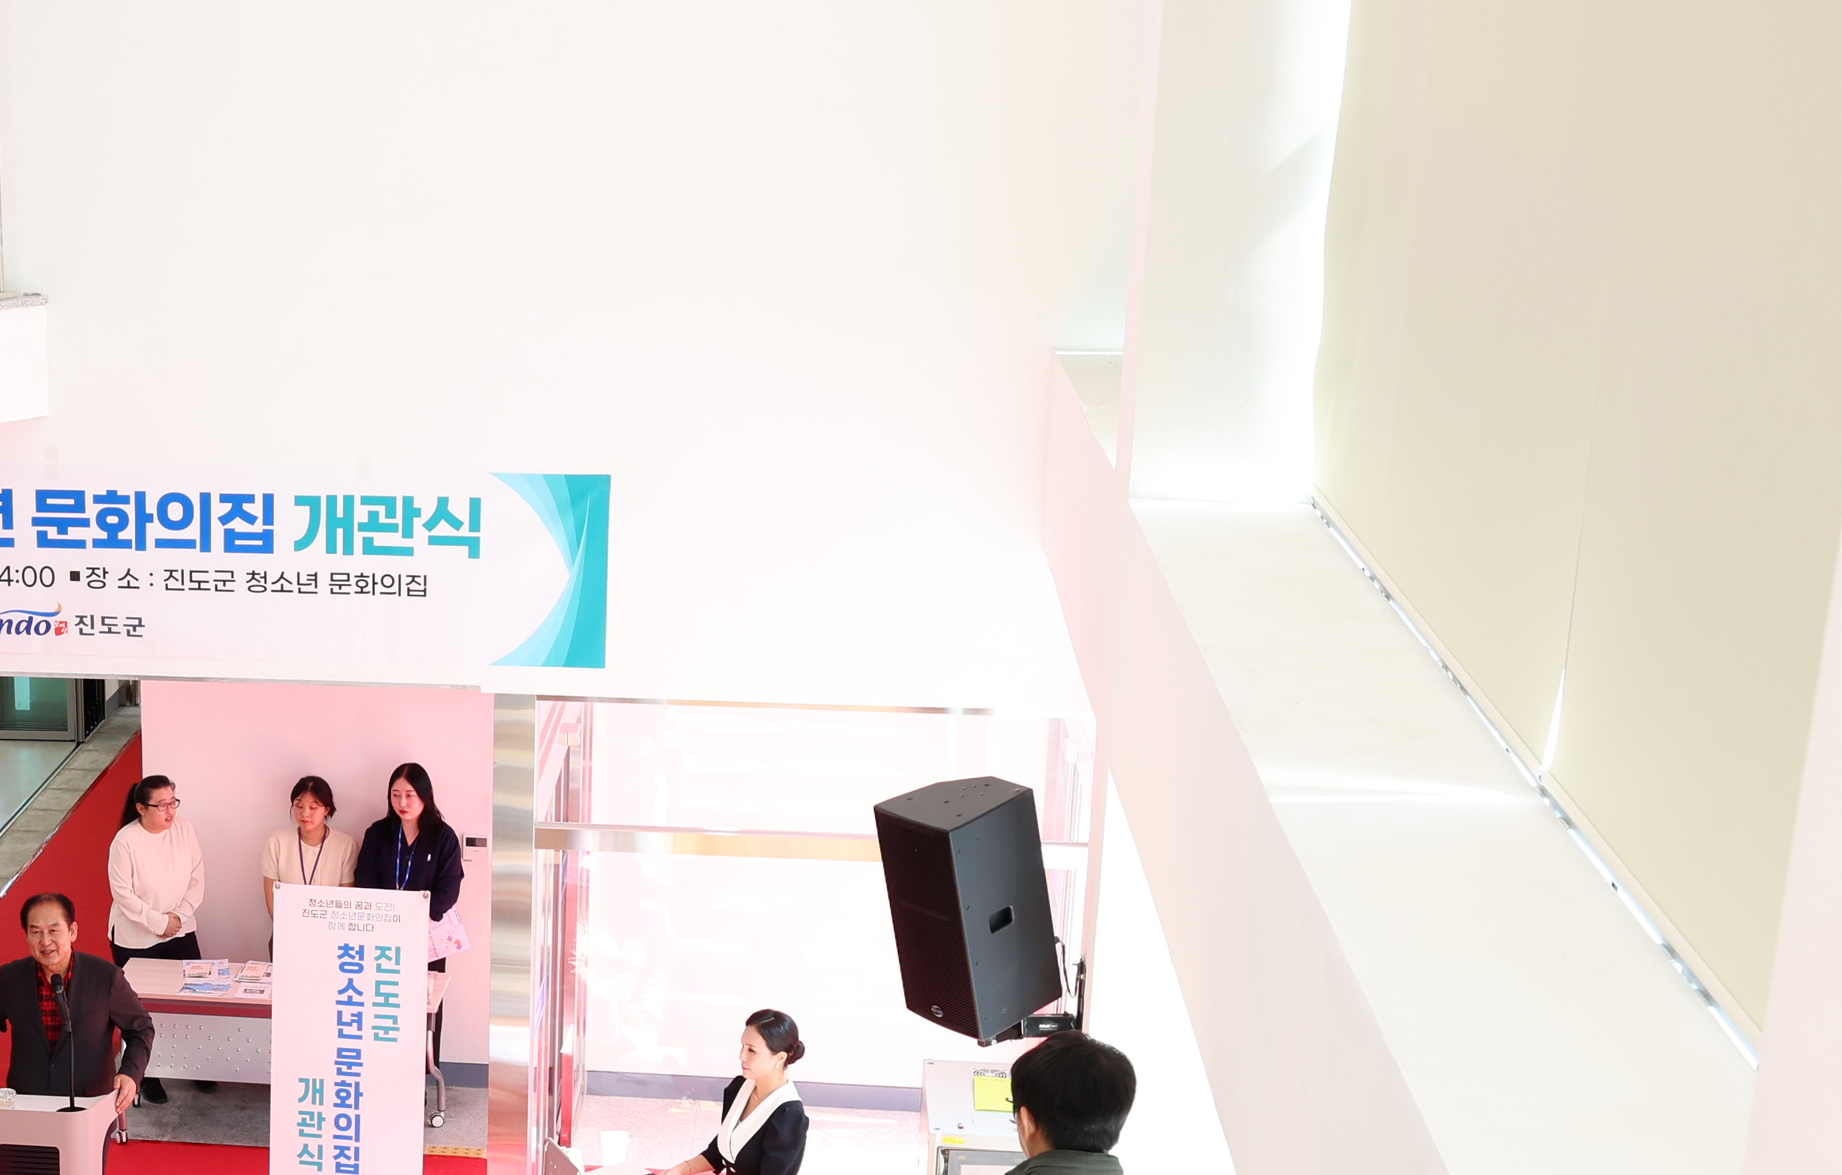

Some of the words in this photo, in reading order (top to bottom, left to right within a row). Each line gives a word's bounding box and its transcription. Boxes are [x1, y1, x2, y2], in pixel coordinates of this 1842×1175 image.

[31, 488, 274, 554] 문화의집
[293, 494, 481, 559] 개관식
[84, 566, 109, 590] 장
[117, 568, 141, 590] 소
[163, 568, 236, 593] 진도군
[245, 569, 319, 595] 청소년
[328, 571, 428, 597] 문화의집
[74, 614, 146, 637] 진도군
[302, 908, 328, 919] 진도군
[330, 910, 401, 923] 청소년문화의집이
[308, 898, 352, 909] 청소년들의
[354, 900, 373, 910] 꿈과
[375, 902, 395, 912] 도전!
[327, 921, 346, 931] 함께
[348, 922, 375, 933] 합니다
[335, 943, 365, 1040] 청소년
[371, 945, 401, 1042] 진도군
[296, 1077, 326, 1172] 개관식
[332, 1046, 364, 1175] 문화의집
